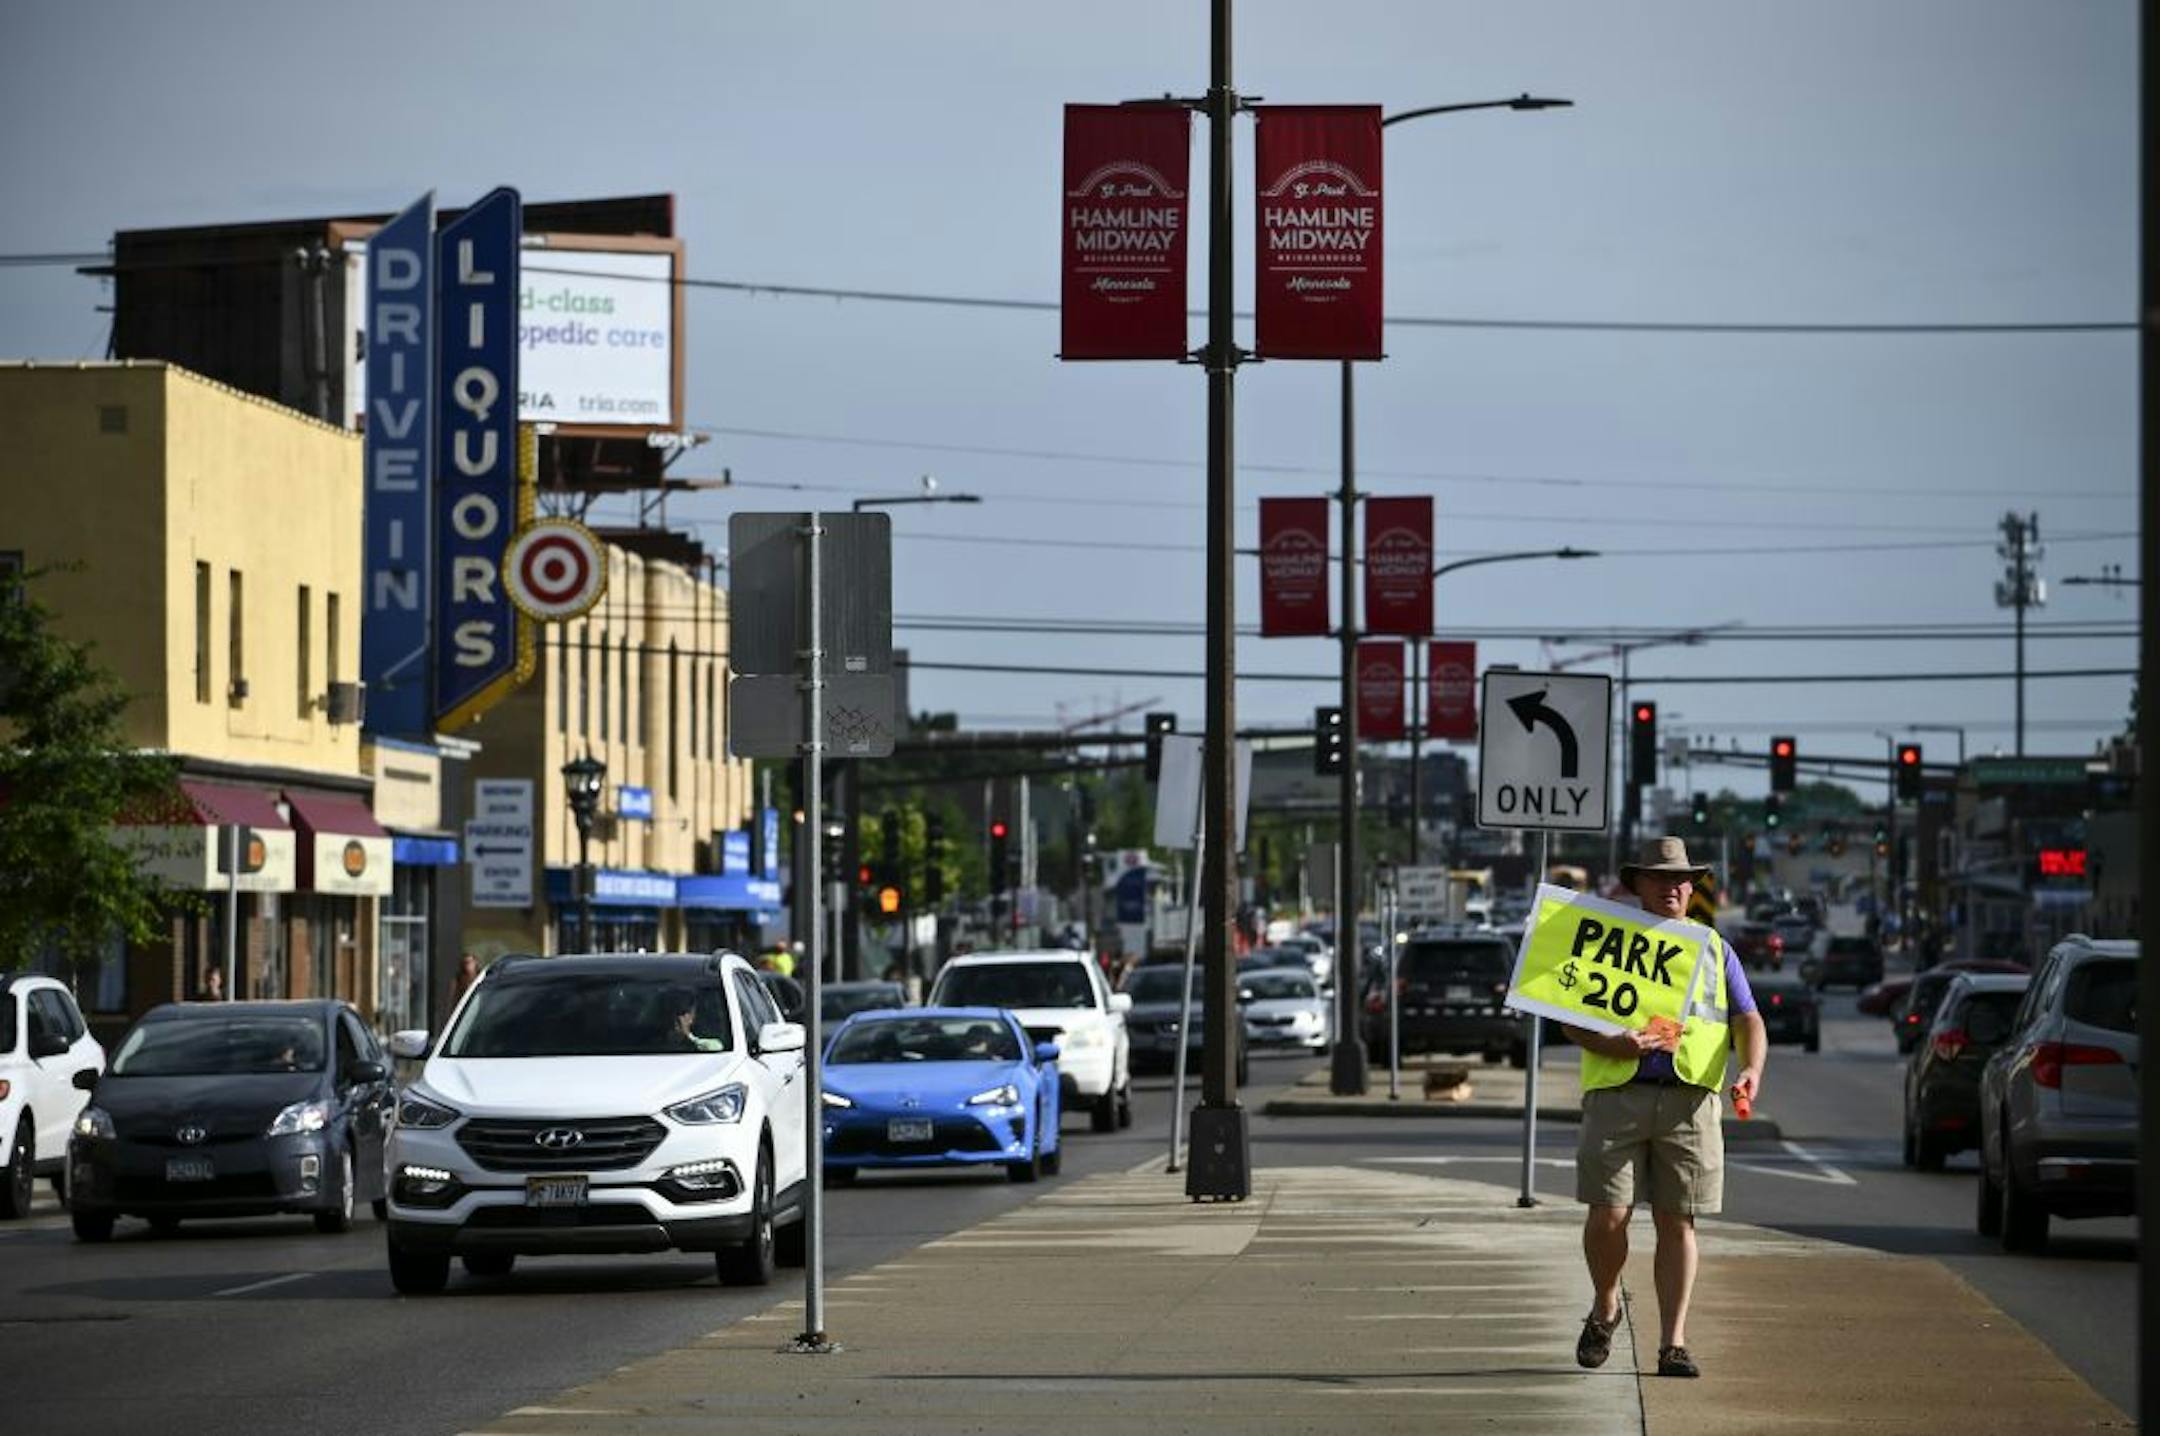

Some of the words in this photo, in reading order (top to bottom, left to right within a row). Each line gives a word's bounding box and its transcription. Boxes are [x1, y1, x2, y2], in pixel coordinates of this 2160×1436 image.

[1119, 183, 1154, 197] Paul
[1312, 182, 1347, 197] Paul
[1070, 207, 1180, 229] HAMLINE
[1264, 207, 1375, 228] HAMLINE
[1076, 229, 1176, 251] MIDWAY
[1269, 229, 1371, 250] MIDWAY
[1091, 276, 1155, 292] Minnesota
[1286, 276, 1351, 292] Minnesota
[607, 328, 665, 348] care
[375, 247, 422, 491] DRIVE
[579, 394, 659, 413] tria.com
[452, 238, 499, 668] LIQUORS
[374, 519, 418, 611] IN
[1497, 783, 1590, 817] ONLY
[465, 825, 530, 838] PARKING
[1571, 917, 1683, 987] PARK
